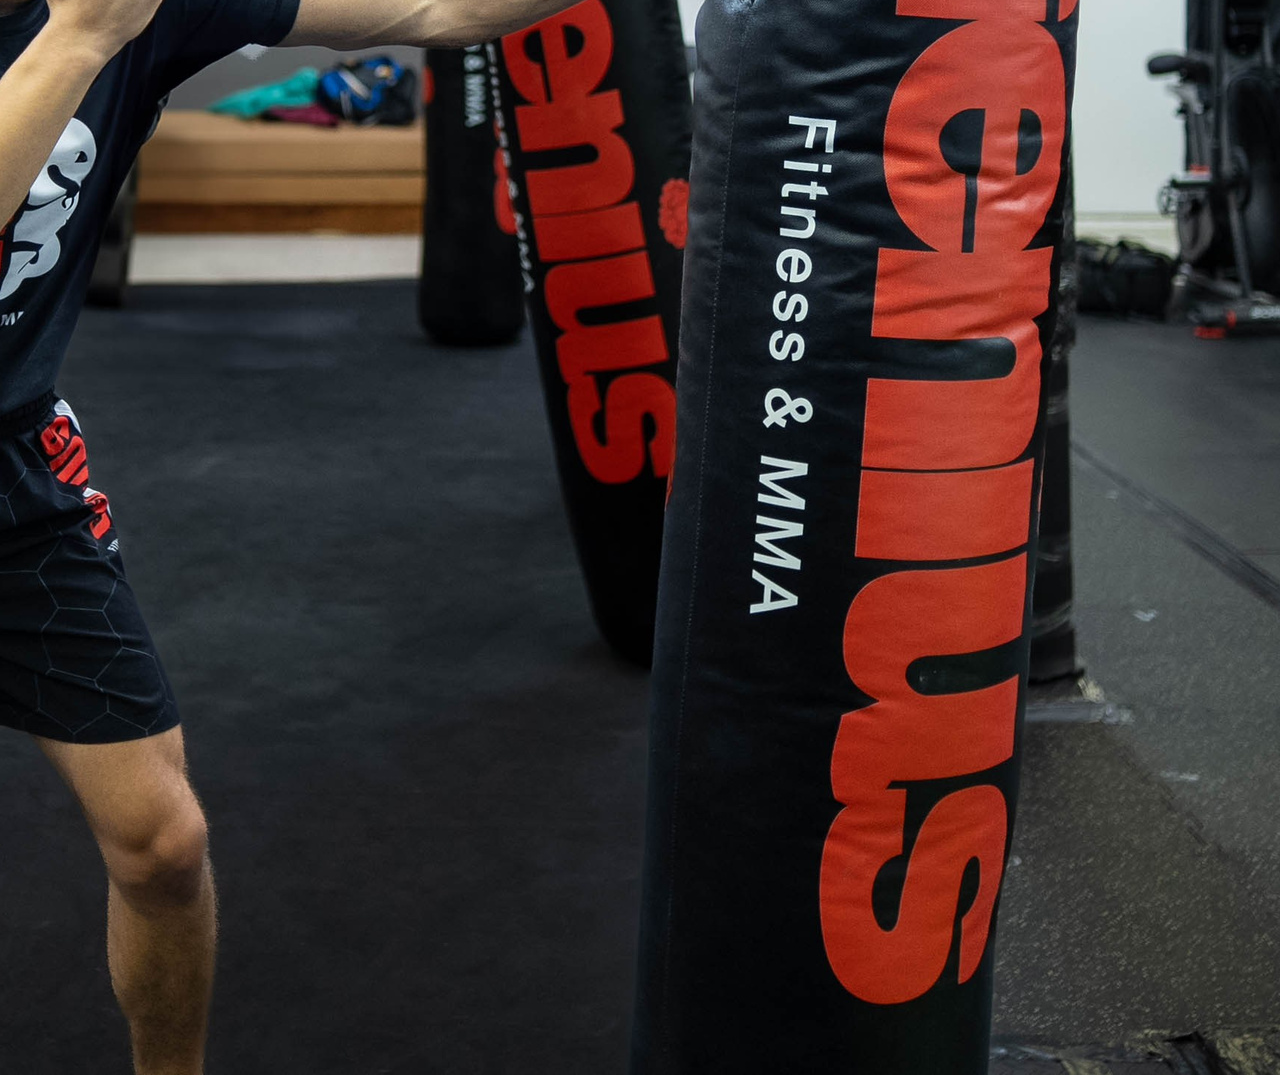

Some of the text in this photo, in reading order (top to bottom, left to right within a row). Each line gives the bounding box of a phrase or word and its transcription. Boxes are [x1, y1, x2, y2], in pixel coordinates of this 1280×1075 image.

[464, 73, 486, 128] MMA
[749, 115, 837, 614] Fitness & MMA
